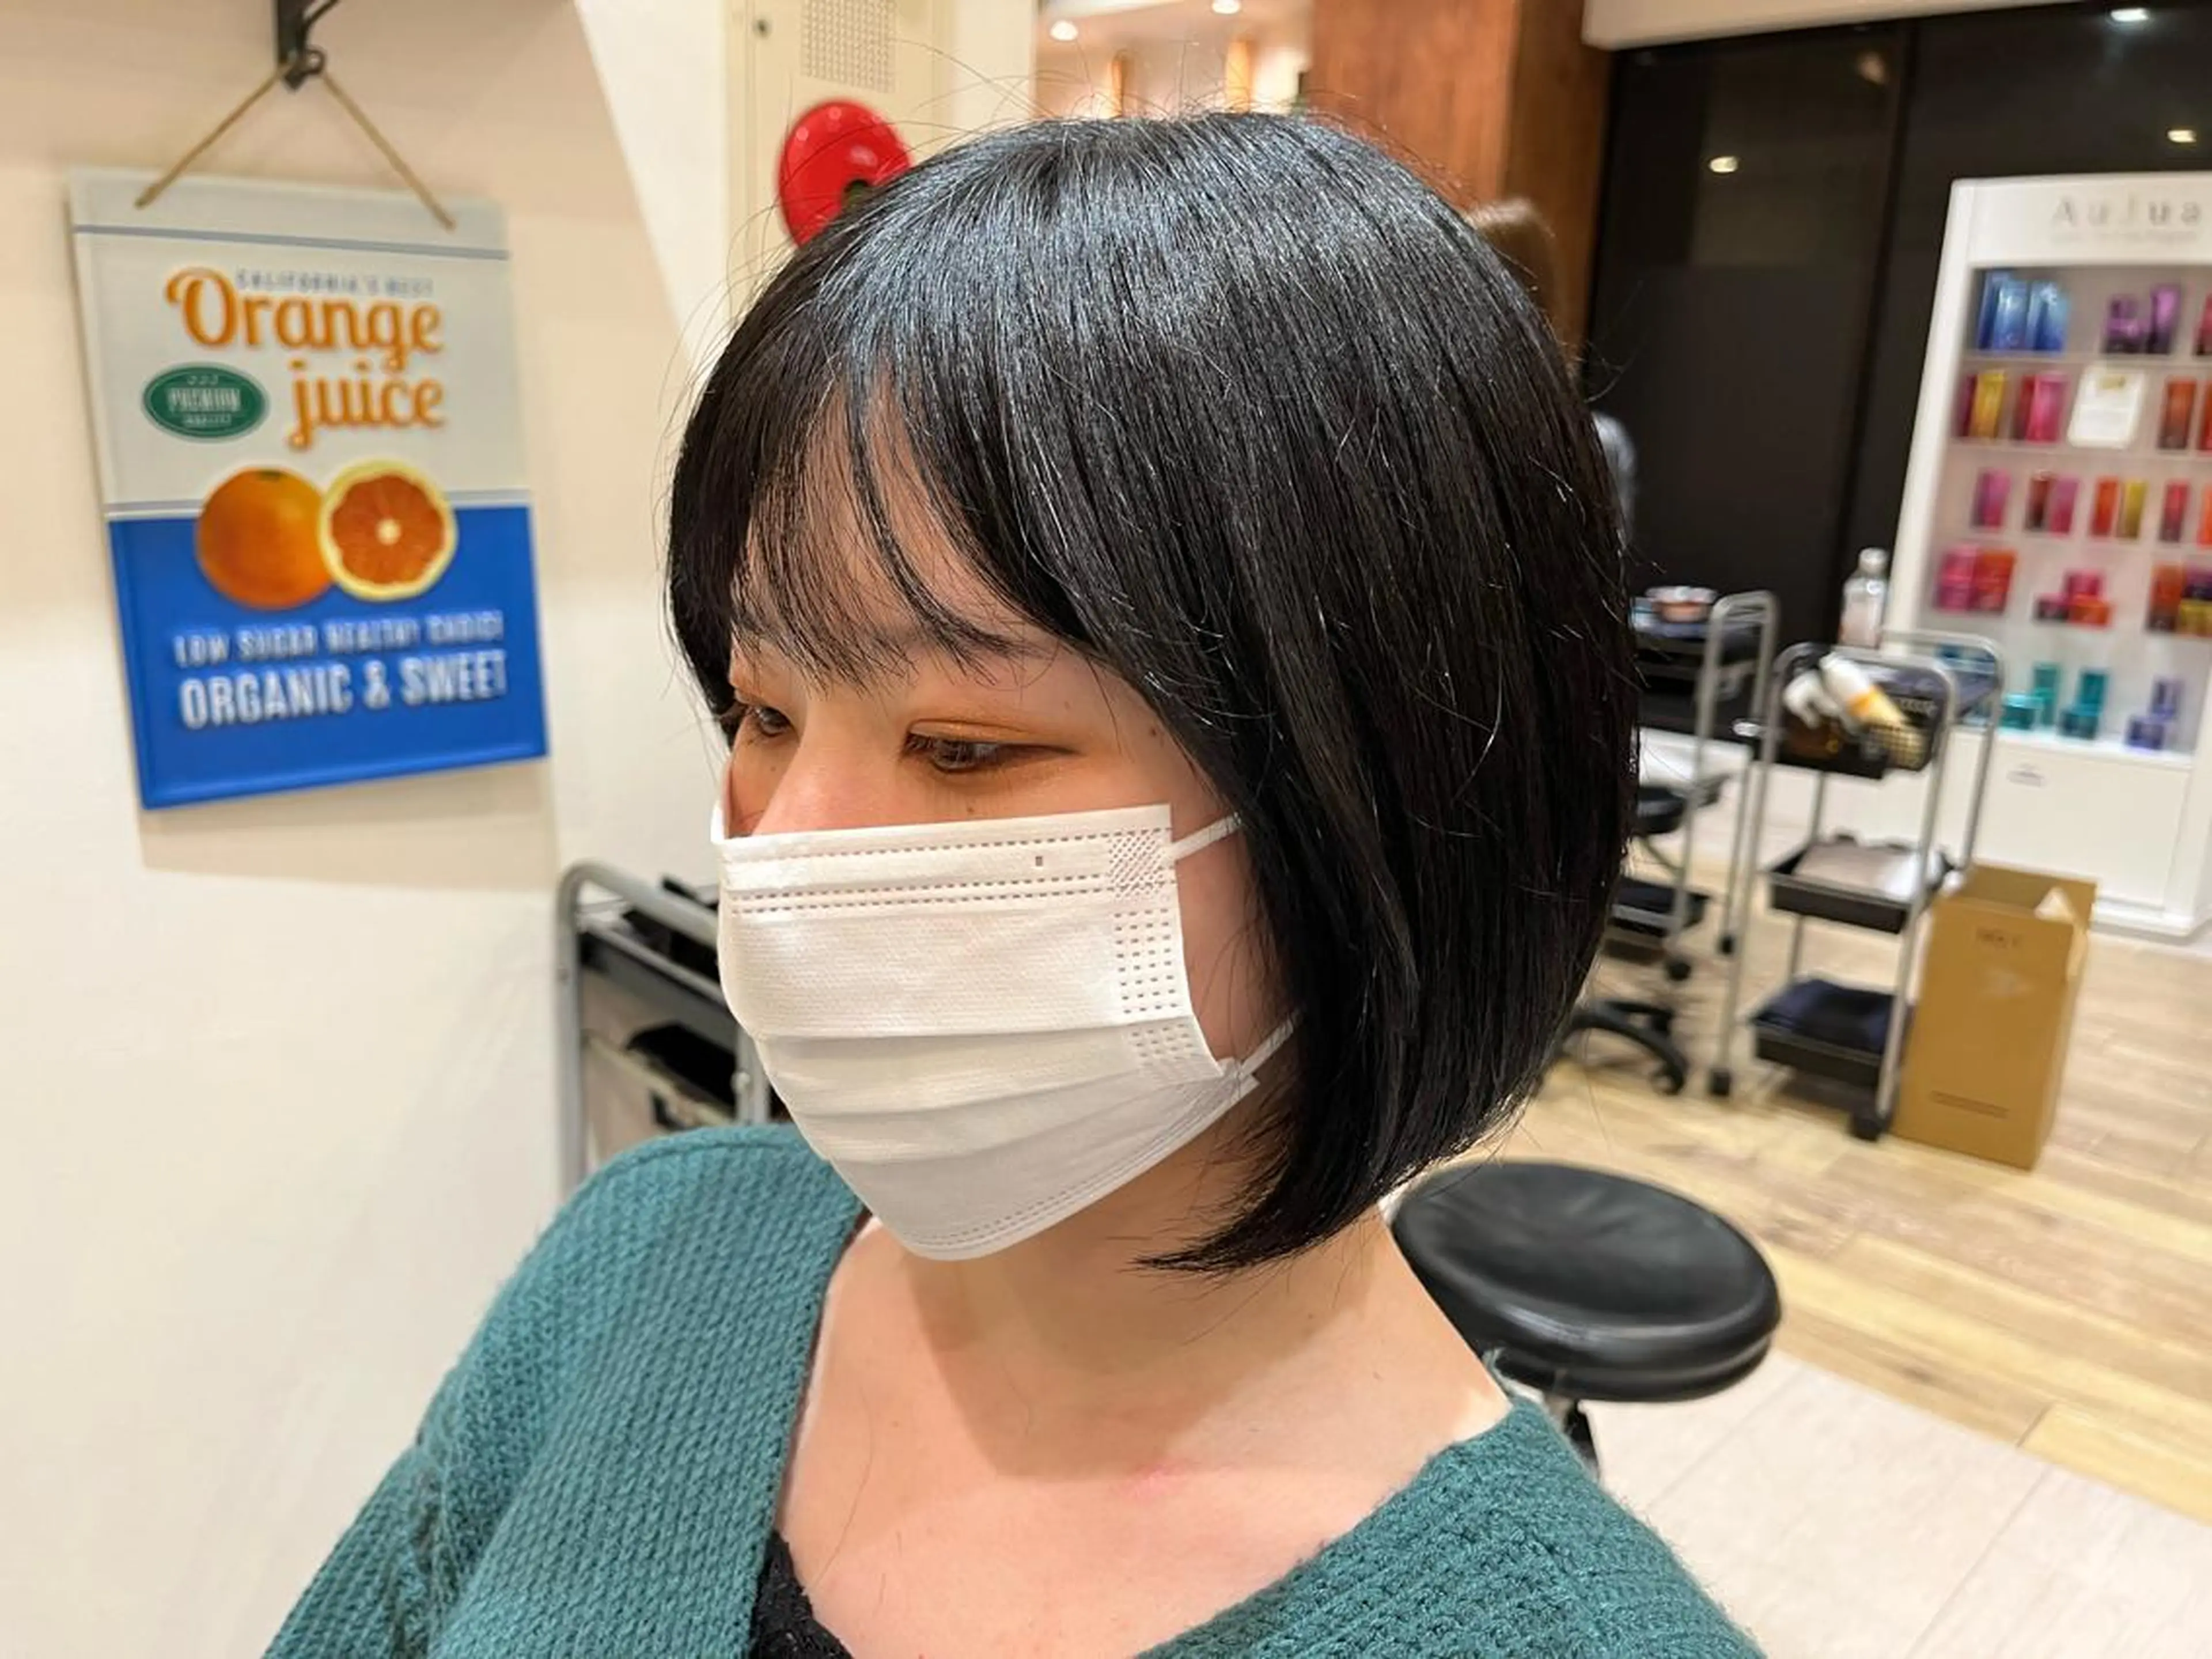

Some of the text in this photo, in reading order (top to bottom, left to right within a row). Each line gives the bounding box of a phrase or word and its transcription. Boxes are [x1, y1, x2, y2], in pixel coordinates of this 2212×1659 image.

[166, 266, 445, 372] Orange
[286, 359, 445, 452] juice
[174, 632, 229, 668] LOW
[179, 650, 506, 730] ORGANIC & SWEET
